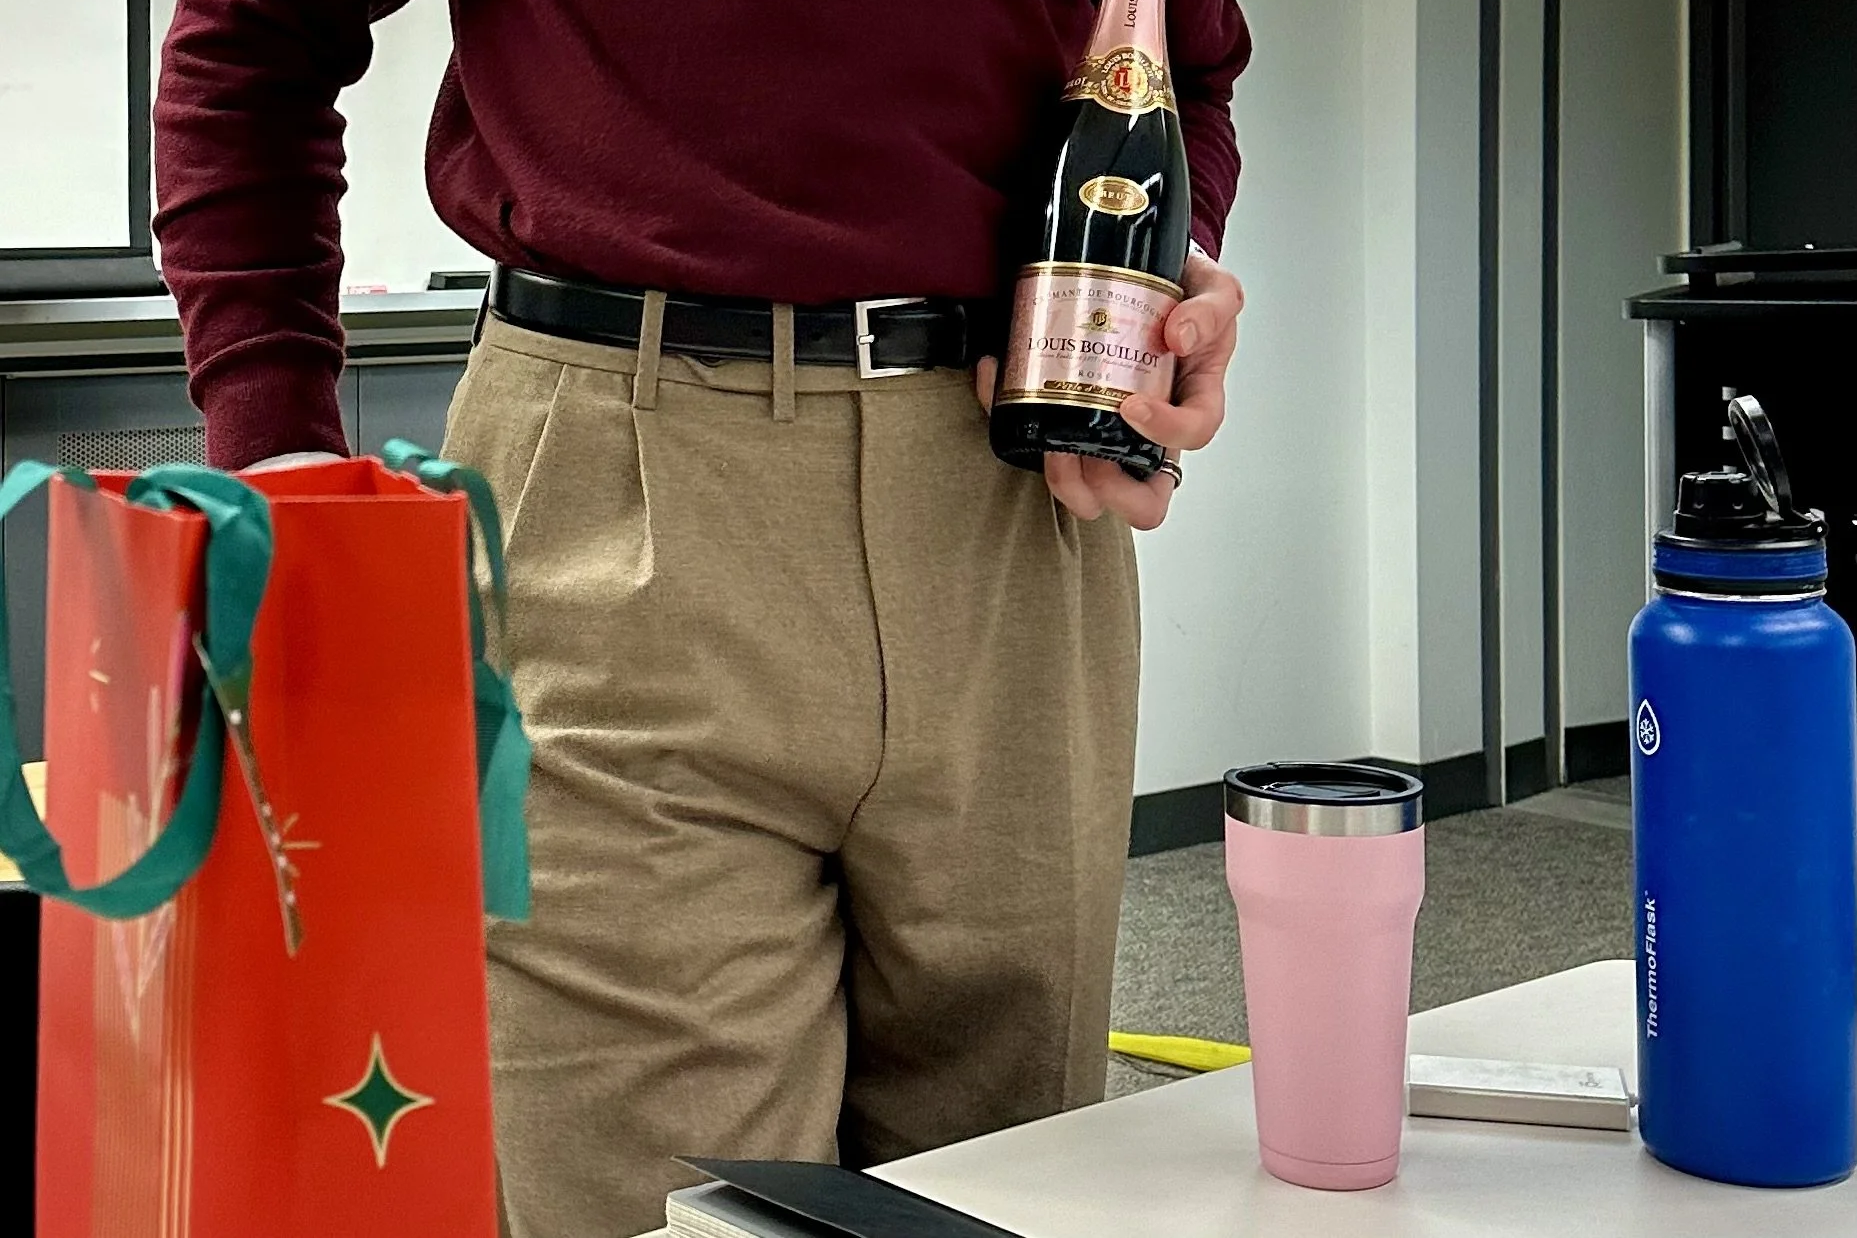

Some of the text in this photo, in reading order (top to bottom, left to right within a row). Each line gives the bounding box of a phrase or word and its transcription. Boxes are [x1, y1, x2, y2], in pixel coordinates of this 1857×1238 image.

[1033, 288, 1083, 307] CMANT
[1027, 337, 1076, 353] LOUIS
[1080, 339, 1160, 368] BOUILLOT
[1645, 898, 1658, 1039] ThermoFlask
